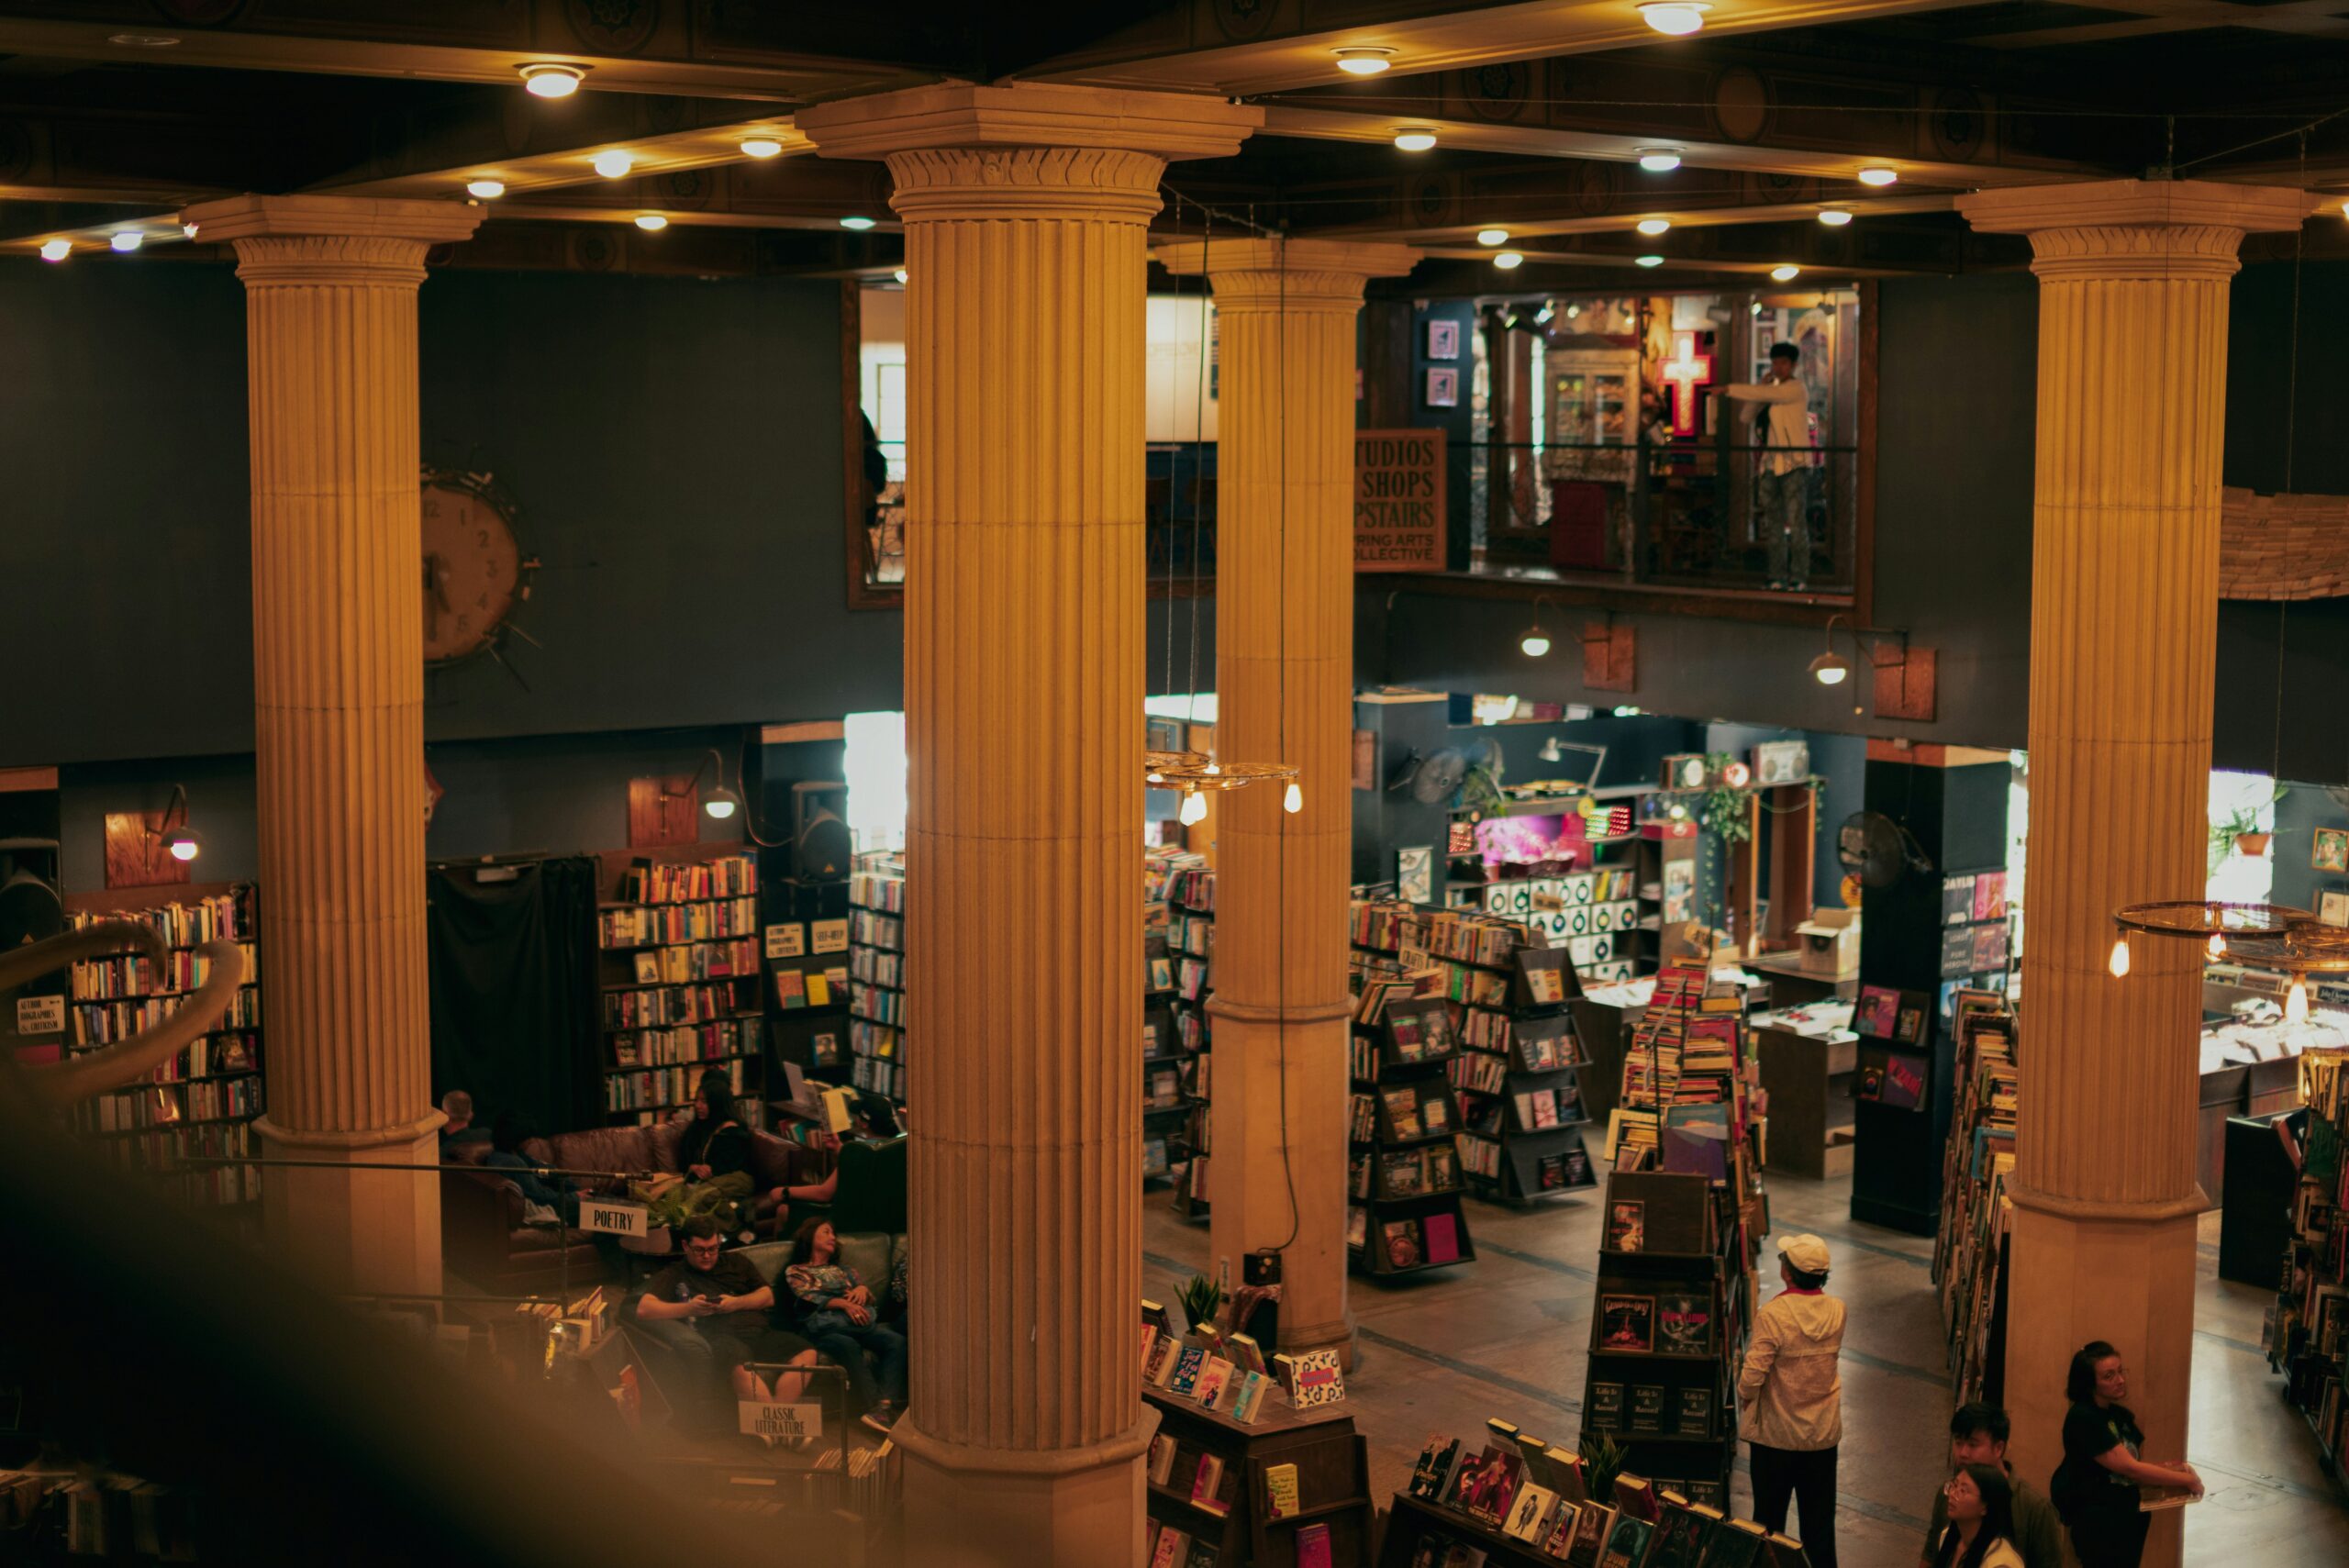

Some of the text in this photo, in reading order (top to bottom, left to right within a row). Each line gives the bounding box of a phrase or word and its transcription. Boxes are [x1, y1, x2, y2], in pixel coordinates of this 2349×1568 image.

[1355, 439, 1434, 467] TUDIOS
[1363, 470, 1434, 498] SHOPS
[1354, 501, 1434, 529] PSTAIRS
[477, 528, 489, 550] 2
[1396, 534, 1434, 547] ARTS
[486, 558, 497, 579] 3
[475, 592, 487, 610] 4
[594, 1209, 634, 1231] POETRY
[763, 1407, 796, 1421] CLASSIC
[755, 1419, 805, 1435] LITERATURE
